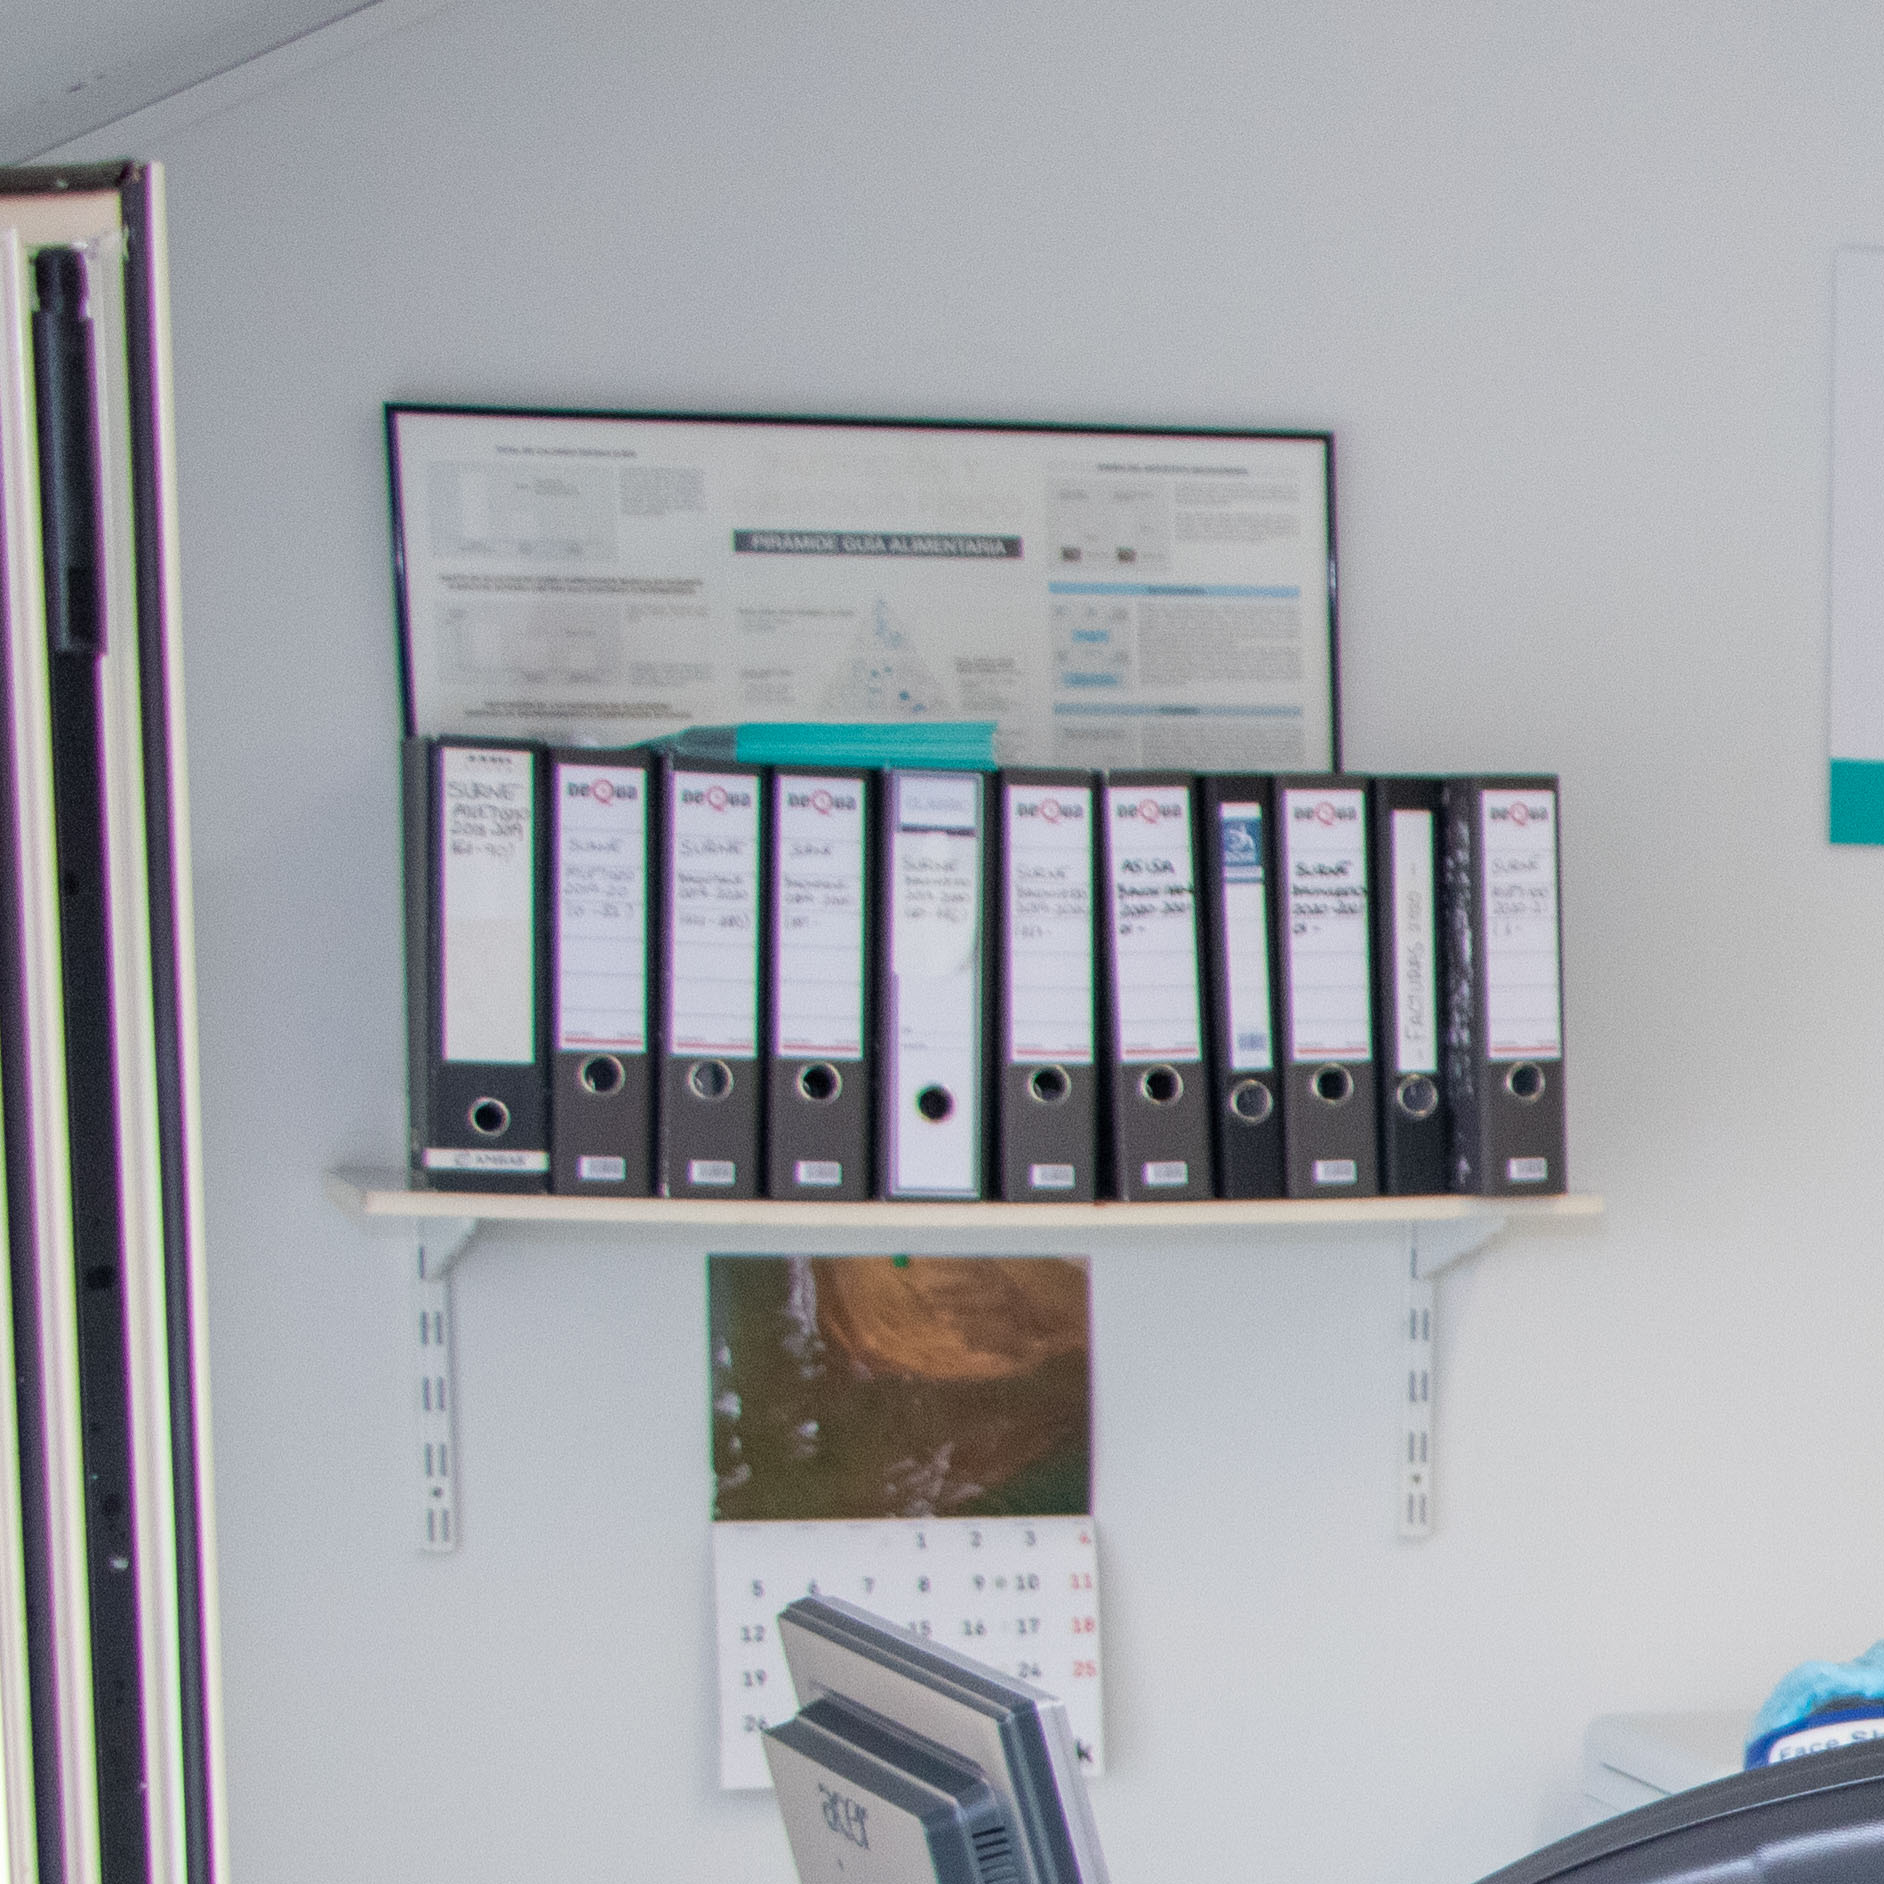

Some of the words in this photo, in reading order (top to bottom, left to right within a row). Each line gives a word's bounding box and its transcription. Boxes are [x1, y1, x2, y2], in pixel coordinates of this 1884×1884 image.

[915, 1531, 928, 1550] 1
[970, 1531, 983, 1549] 2
[1025, 1530, 1037, 1547] 3
[751, 1579, 765, 1598] 5
[864, 1577, 876, 1594] 7
[918, 1576, 931, 1593] 8
[972, 1575, 985, 1592] 9
[1015, 1574, 1041, 1592] 10
[1070, 1573, 1093, 1590] 11
[740, 1625, 766, 1643] 12
[962, 1619, 987, 1637] 16
[1016, 1617, 1041, 1635] 17
[743, 1670, 768, 1688] 19
[1073, 1660, 1097, 1678] 25
